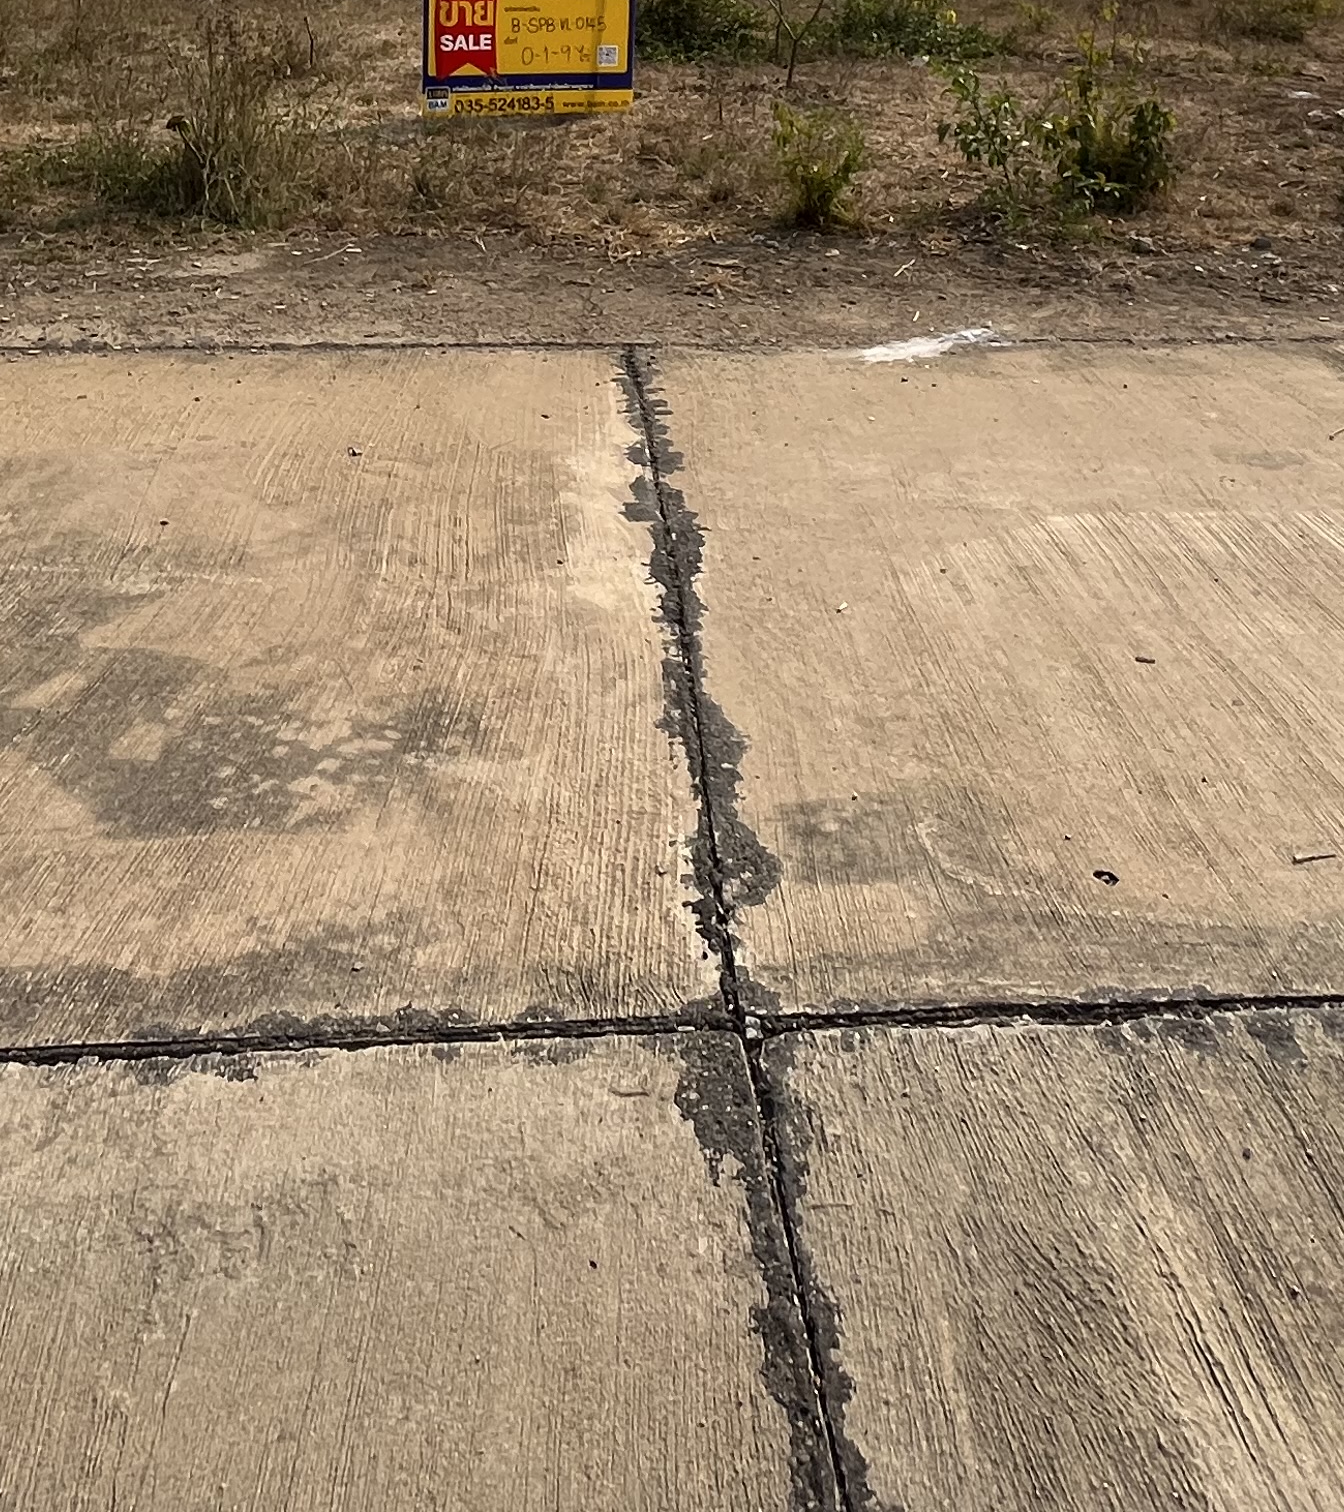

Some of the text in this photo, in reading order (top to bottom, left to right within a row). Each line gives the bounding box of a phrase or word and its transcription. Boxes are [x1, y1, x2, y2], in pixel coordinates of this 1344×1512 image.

[439, 0, 494, 27] ขาย
[439, 33, 493, 52] SALE
[454, 96, 554, 113] 035-524183-5
